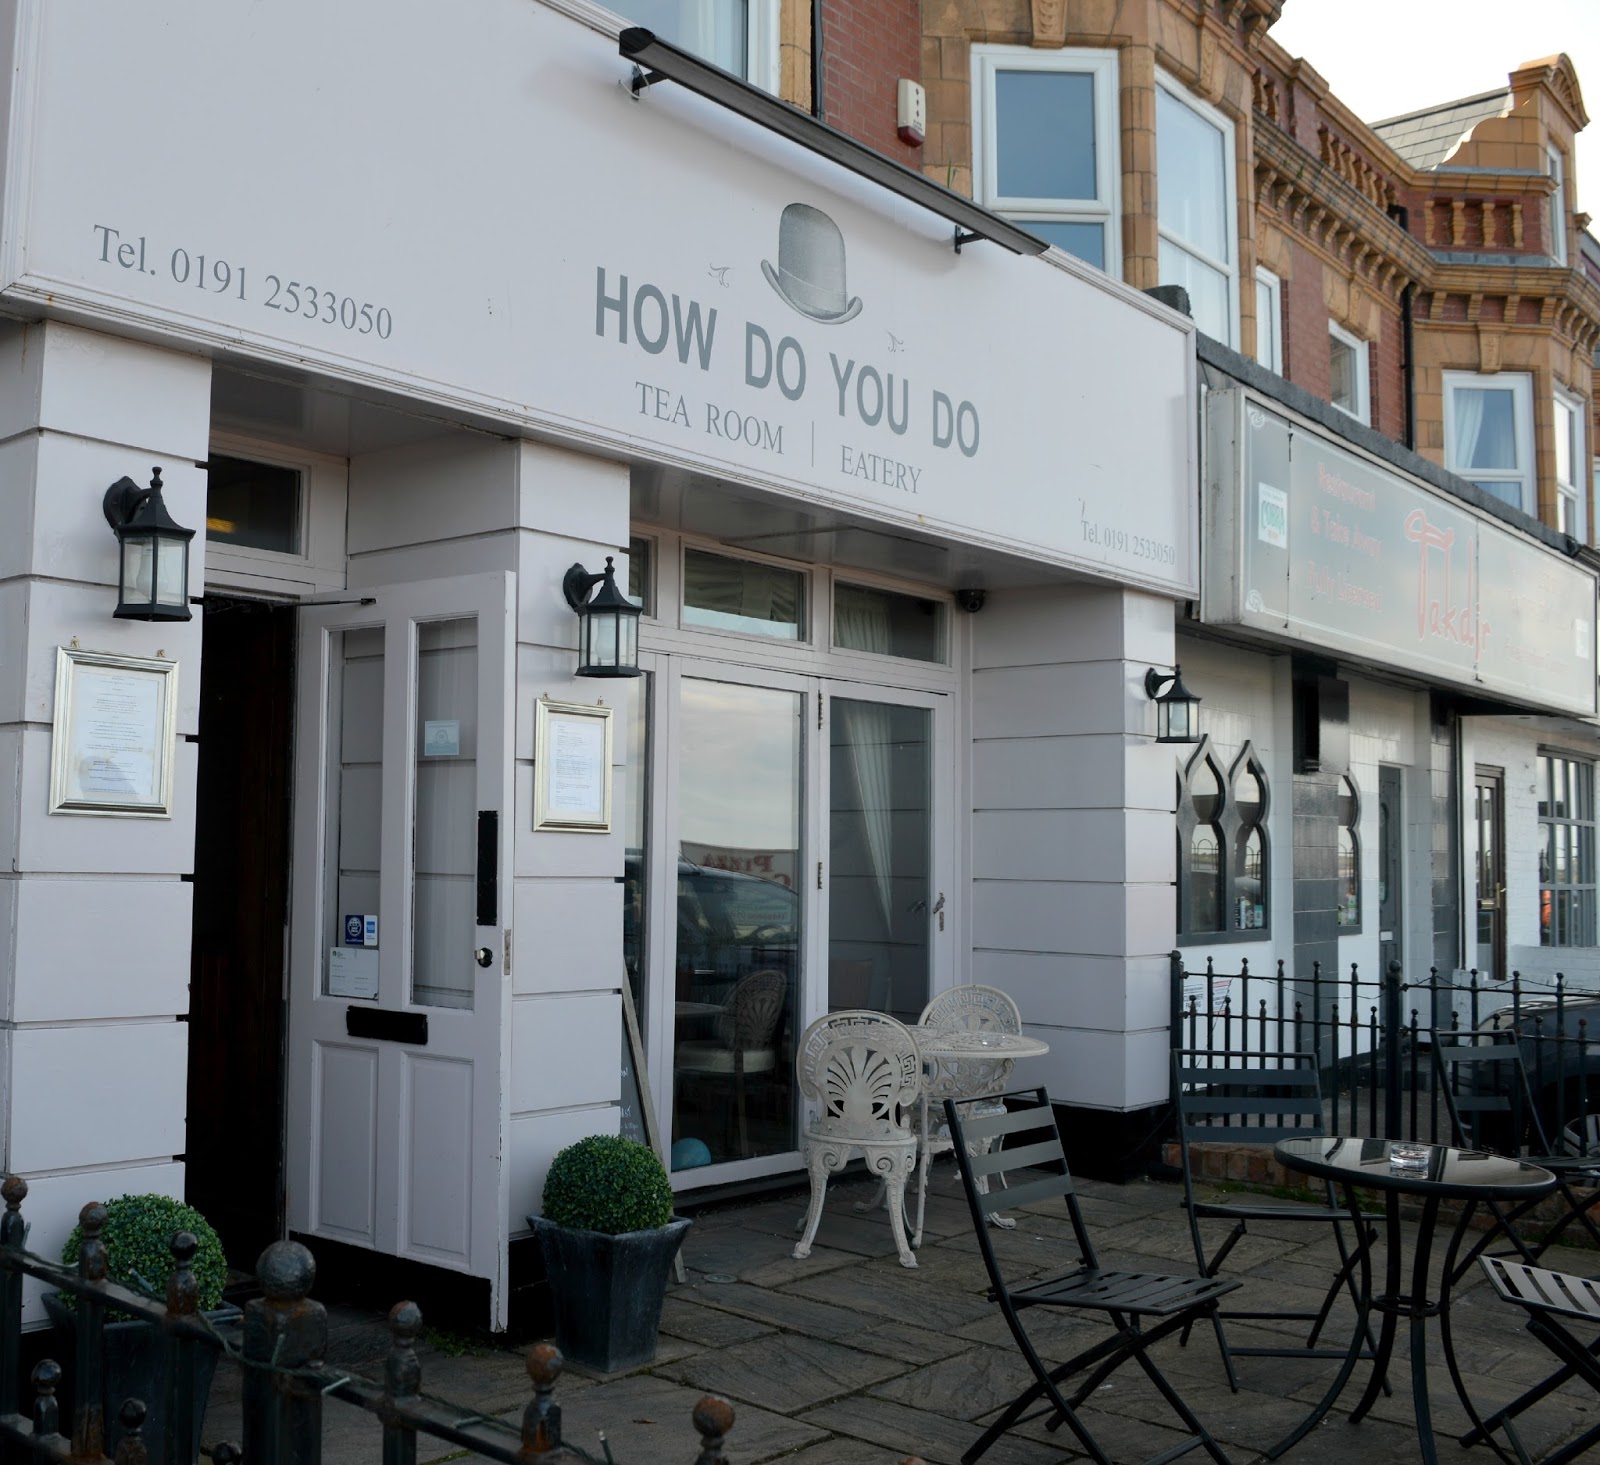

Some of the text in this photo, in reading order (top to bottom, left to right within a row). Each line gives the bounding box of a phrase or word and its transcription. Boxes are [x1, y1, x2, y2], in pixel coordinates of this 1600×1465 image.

[93, 224, 392, 339] Tel. 0191 2533050
[596, 266, 980, 458] HOW DO YOU DO
[635, 381, 784, 455] TEA ROOM
[840, 445, 922, 494] EATERY
[1317, 462, 1377, 513] Restaurant
[1081, 520, 1175, 565] Tel. 0191 2533050
[1324, 509, 1351, 545] Take
[1354, 523, 1382, 561] Away
[1306, 559, 1383, 613] Fully Licensed
[1404, 508, 1492, 662] Takdir
